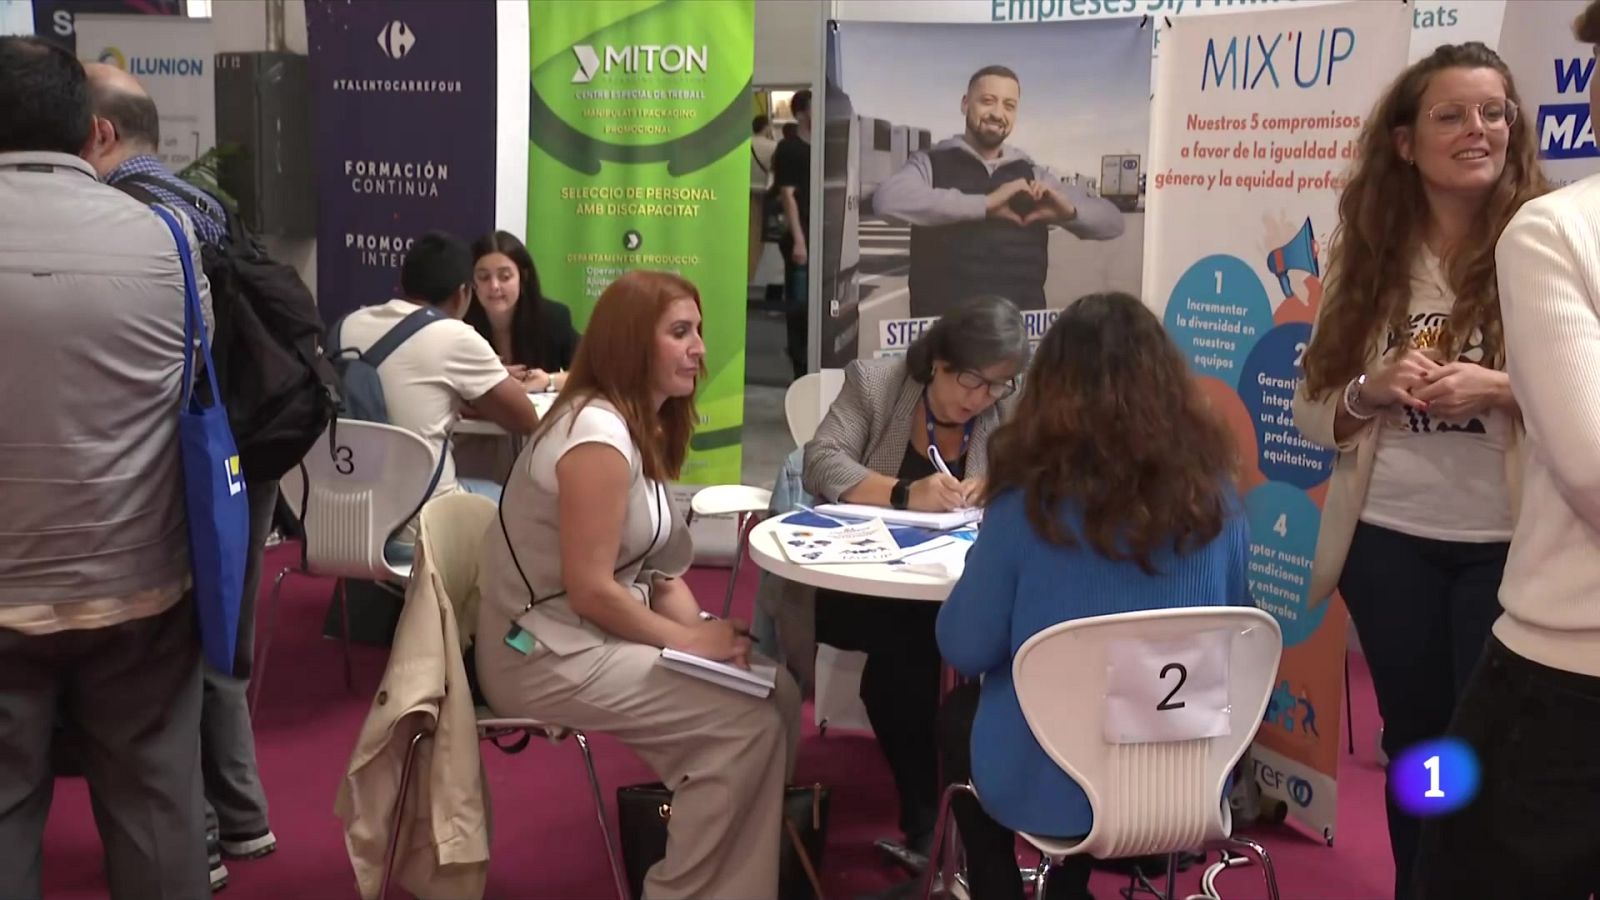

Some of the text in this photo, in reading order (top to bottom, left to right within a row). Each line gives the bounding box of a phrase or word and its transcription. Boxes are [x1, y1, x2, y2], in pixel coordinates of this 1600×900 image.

[130, 57, 203, 76] ILUNION
[604, 45, 708, 73] MITON
[333, 79, 462, 92] #TALENTOCARREFOUR
[1555, 58, 1597, 93] W
[1186, 110, 1360, 134] Nuestros 5 compromisos
[1181, 147, 1189, 158] a
[1193, 141, 1230, 159] favor
[1233, 141, 1249, 159] de
[1253, 141, 1266, 159] la
[1270, 141, 1337, 163] igualdad
[344, 160, 448, 180] FORMACIÓN
[1155, 169, 1205, 189] género
[1207, 174, 1216, 191] y
[1219, 170, 1232, 187] la
[1236, 170, 1294, 191] equidad
[352, 178, 438, 197] CONTINUA
[626, 187, 642, 199] DE
[646, 187, 717, 201] PERSONAL
[576, 204, 699, 216] AMB DISCAPACITAT
[1214, 270, 1223, 294] 1
[1186, 298, 1248, 317] Incrementar
[1177, 314, 1255, 335] la diversidad en
[1192, 335, 1236, 351] nuestros
[1194, 353, 1234, 371] equipos
[1293, 343, 1307, 367] 2
[1260, 412, 1274, 423] un
[336, 446, 354, 475] 3
[1263, 448, 1323, 471] equitativos
[1273, 513, 1287, 537] 4
[1248, 560, 1304, 586] condiciones
[1248, 579, 1301, 605] y entornos
[1156, 662, 1187, 711] 2
